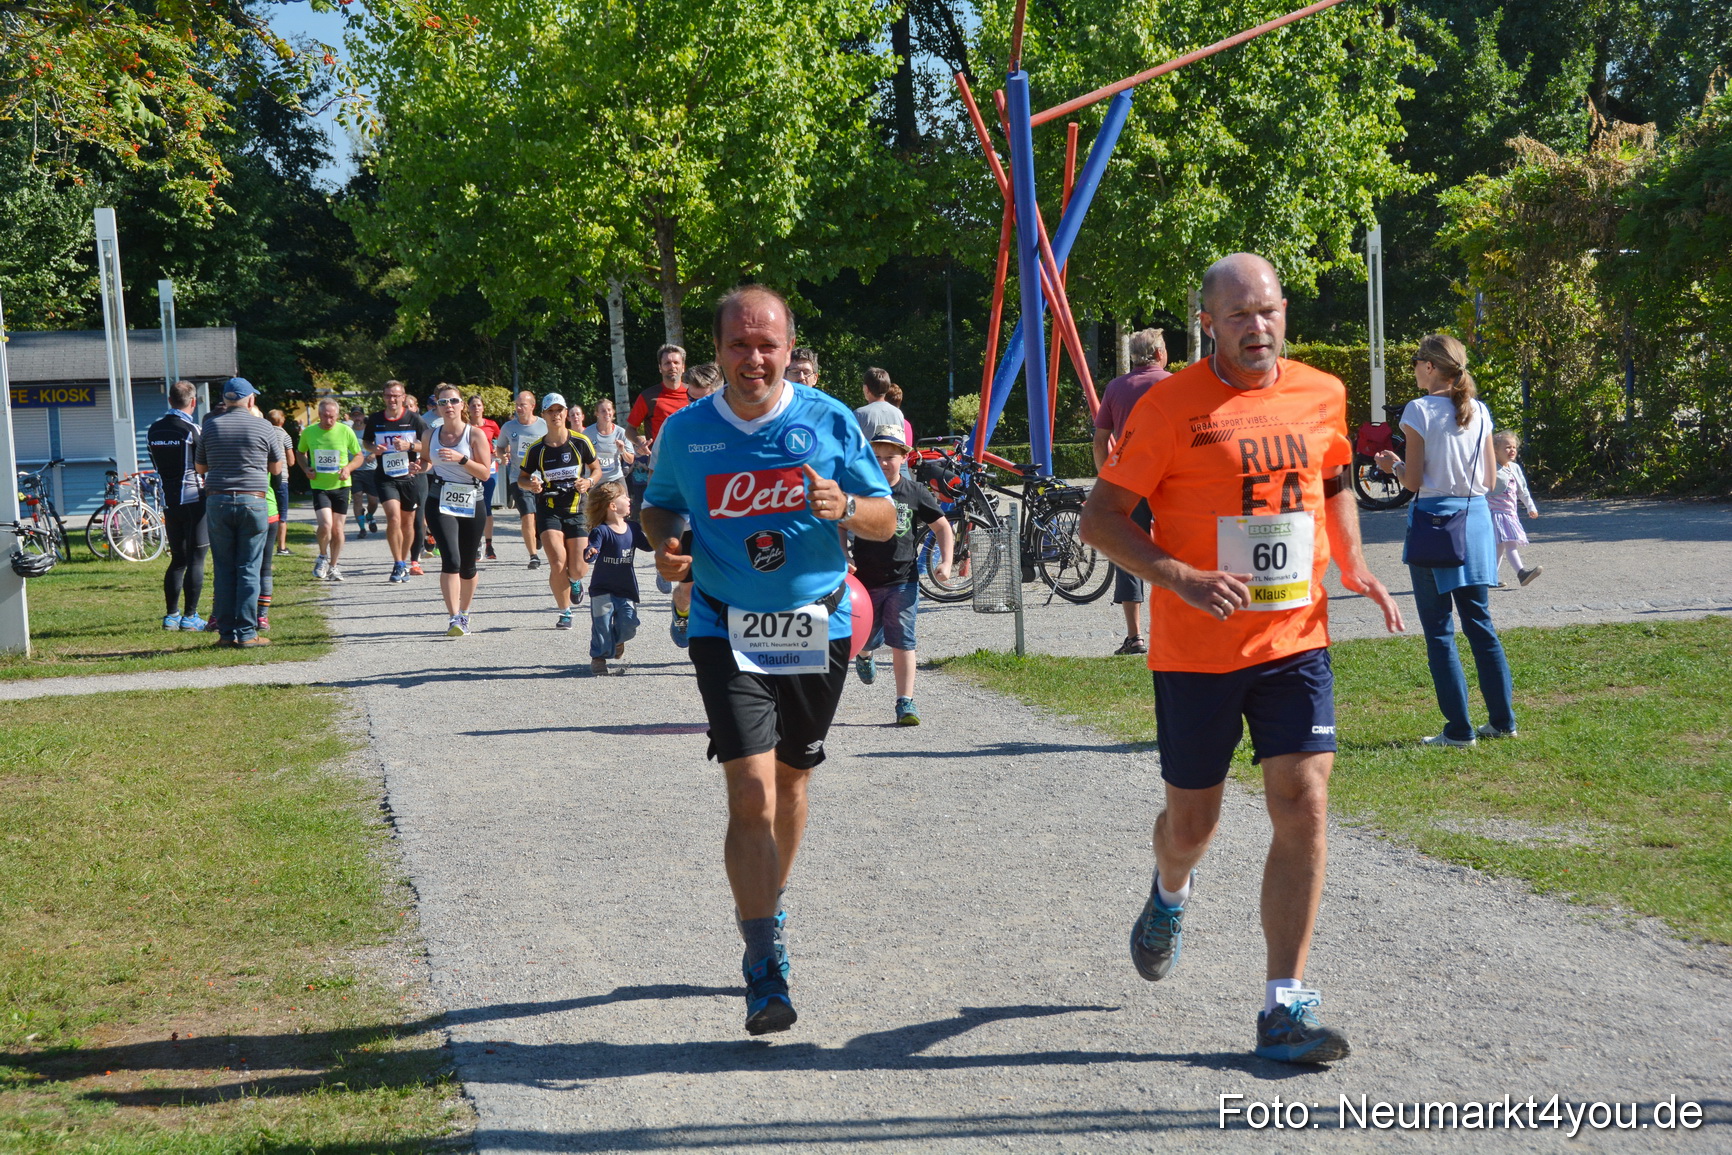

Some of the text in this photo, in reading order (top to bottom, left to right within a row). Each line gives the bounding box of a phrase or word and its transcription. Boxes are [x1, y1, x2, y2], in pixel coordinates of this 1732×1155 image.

[40, 388, 91, 403] KIOSK
[1190, 421, 1218, 432] URBAN
[1221, 418, 1244, 427] SPORT
[1246, 416, 1268, 424] VIBES
[521, 441, 530, 449] 29
[790, 433, 807, 449] N
[688, 443, 726, 453] Kappa
[1238, 434, 1308, 474] RUN
[318, 455, 337, 464] 2364
[386, 459, 405, 468] 2061
[562, 468, 577, 476] Sport
[445, 491, 471, 503] 2957
[709, 472, 804, 518] Lete
[1248, 523, 1291, 535] BOCK
[603, 556, 619, 564] LITTLE
[1253, 542, 1287, 571] 60
[1264, 574, 1291, 582] Neumarkt
[1255, 588, 1286, 600] Klaus
[742, 612, 813, 638] 2073
[758, 653, 800, 665] Claudio
[1311, 725, 1335, 734] CRAFT
